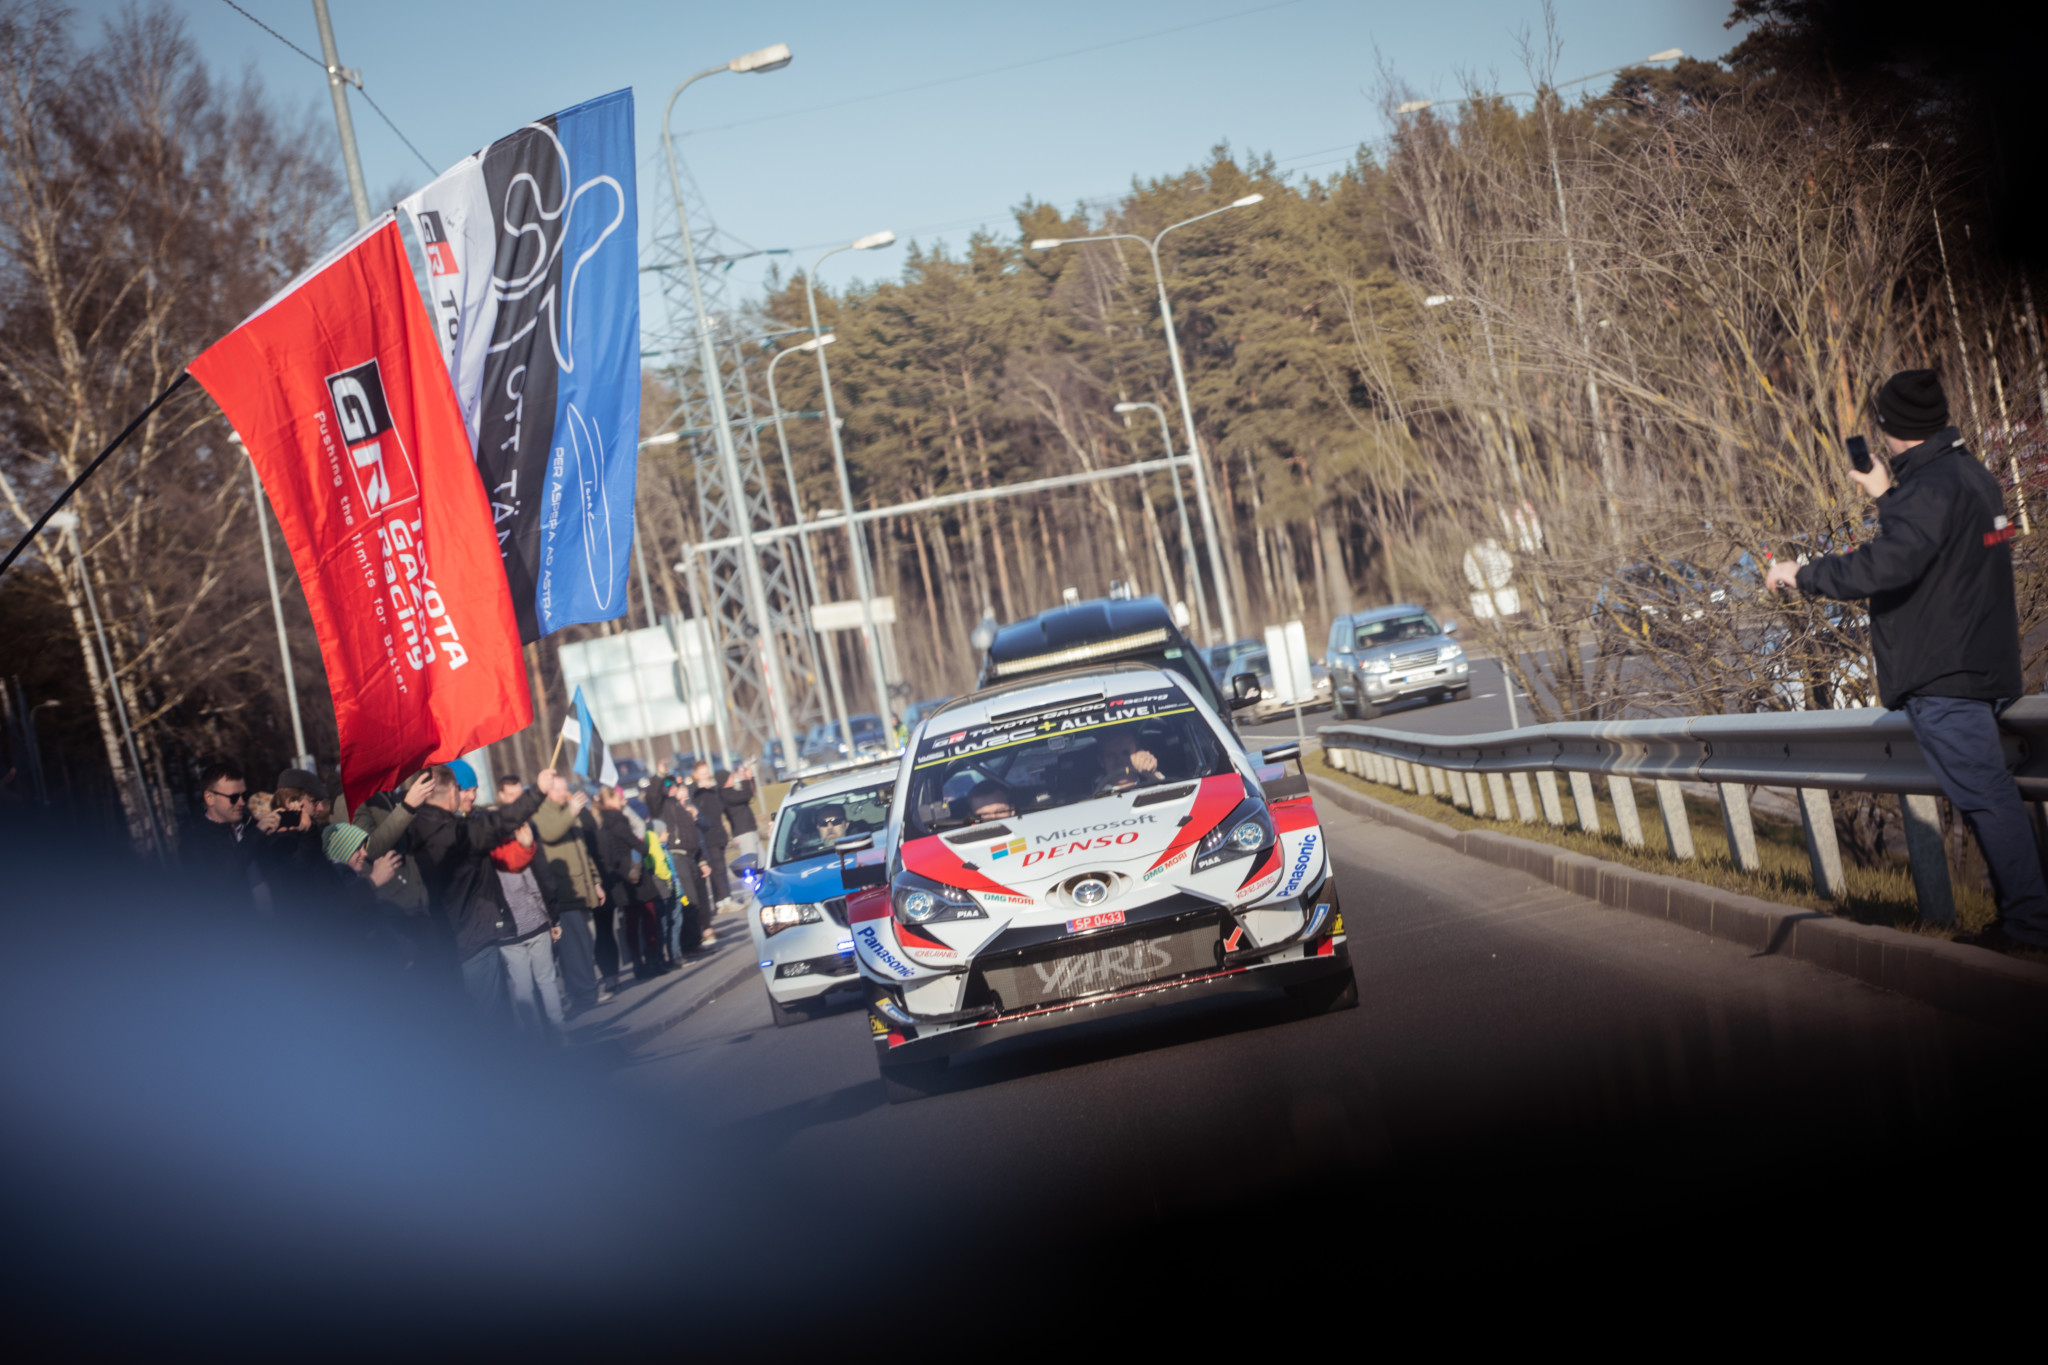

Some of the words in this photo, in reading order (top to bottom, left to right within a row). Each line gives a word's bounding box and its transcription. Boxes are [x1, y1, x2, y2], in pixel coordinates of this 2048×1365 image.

[419, 213, 446, 275] GR
[501, 364, 526, 452] OTT
[332, 376, 391, 511] GR
[552, 446, 565, 478] PER
[313, 410, 343, 488] Pushing
[340, 495, 354, 526] the
[351, 532, 377, 588] limits
[373, 597, 387, 625] for
[383, 634, 408, 694] Better
[377, 525, 424, 671] Racing
[388, 518, 436, 664] GAZOO
[410, 506, 469, 671] TOYOTA
[542, 569, 553, 621] ASTRA
[969, 716, 1039, 738] TOYOTA
[1042, 703, 1106, 720] GAZOO
[1109, 694, 1169, 707] Racing
[1060, 716, 1100, 731] ALL
[1104, 706, 1150, 722] LIVE
[1022, 832, 1140, 868] DENSO
[1035, 814, 1158, 845] Microsoft
[1142, 865, 1164, 882] DMG
[1164, 851, 1188, 869] MORI
[1198, 856, 1221, 868] PIAA
[1275, 833, 1317, 898] Panasonic
[956, 910, 980, 919] PIAA
[983, 893, 1007, 903] DMG
[1008, 896, 1035, 905] MORI
[1075, 916, 1091, 930] SP
[1093, 910, 1122, 926] 0433
[857, 926, 915, 978] Panasonic
